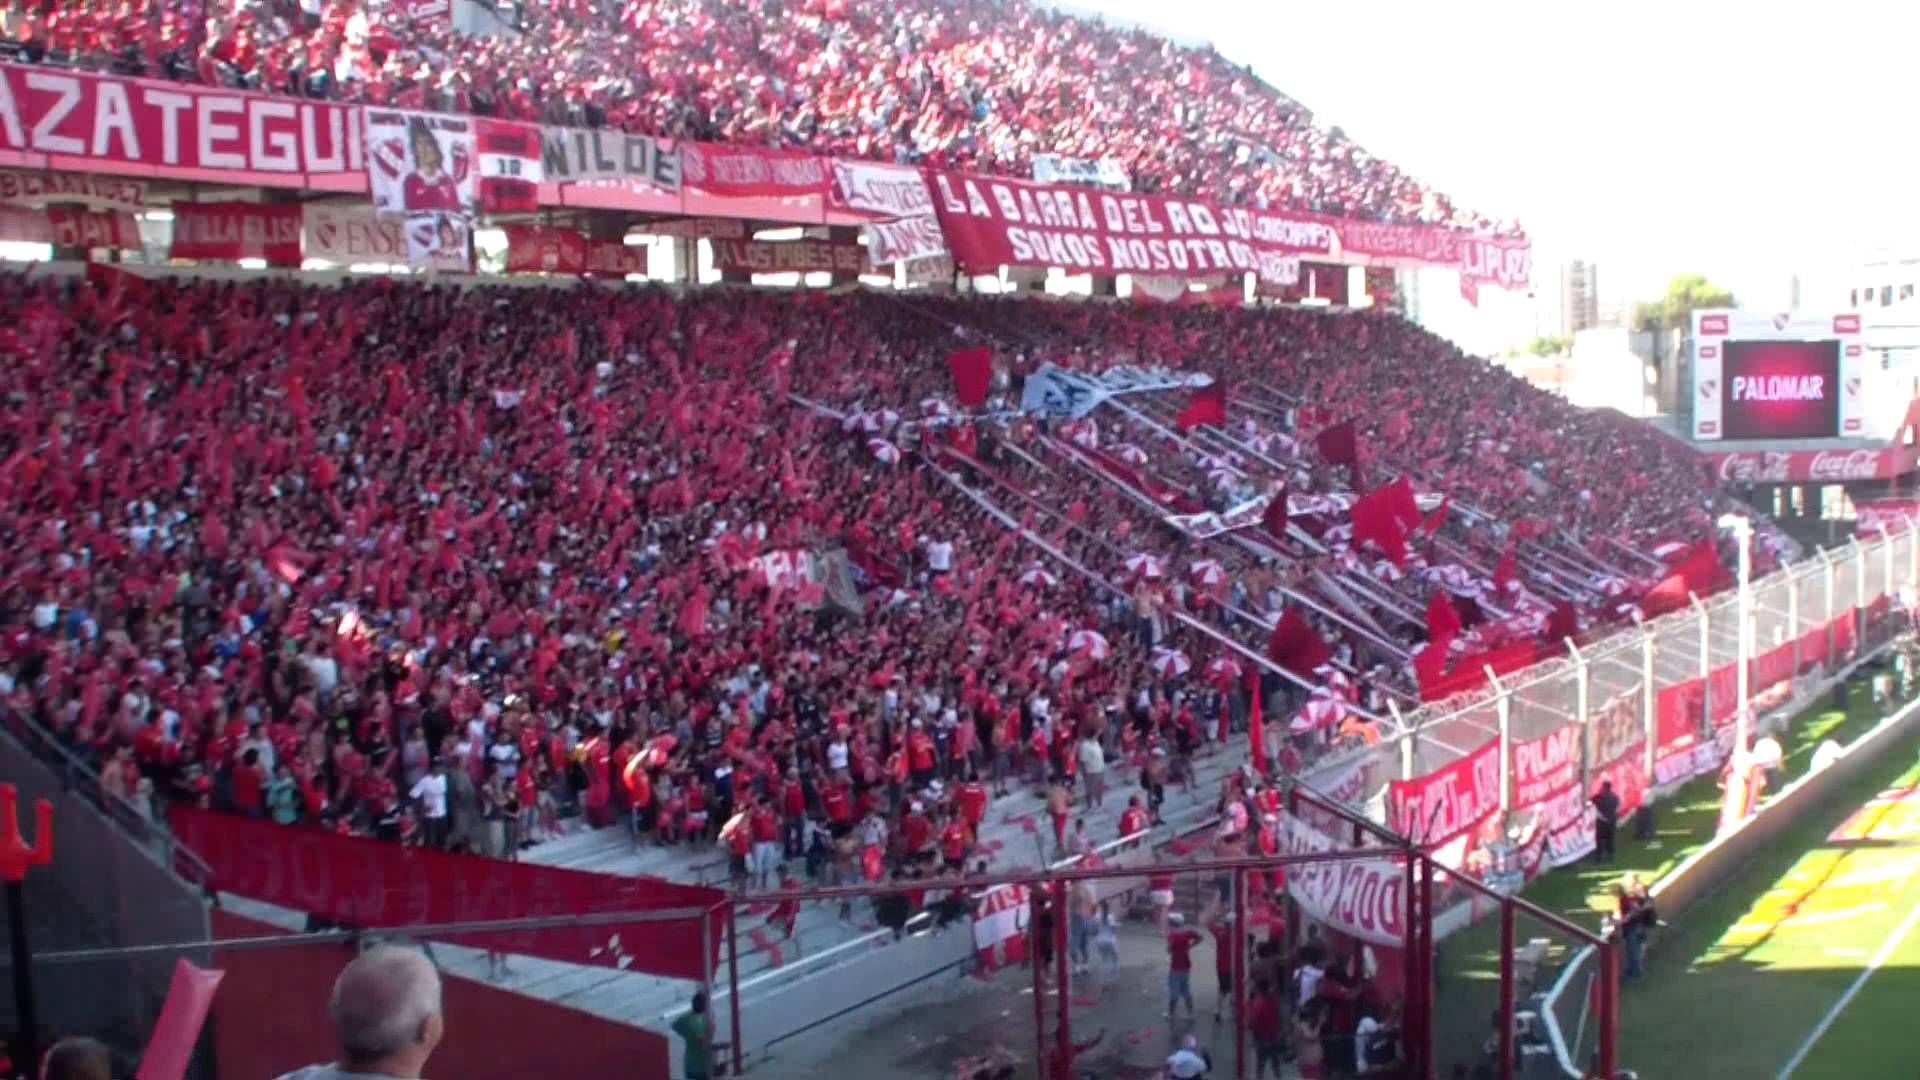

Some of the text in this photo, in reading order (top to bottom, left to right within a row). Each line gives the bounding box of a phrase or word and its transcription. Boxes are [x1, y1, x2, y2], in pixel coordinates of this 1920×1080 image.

[935, 174, 991, 218] LA
[991, 182, 1098, 231] BARRA
[1100, 194, 1164, 234] DEL
[1005, 227, 1105, 268] SOMOS
[1732, 374, 1825, 402] PALOMAR
